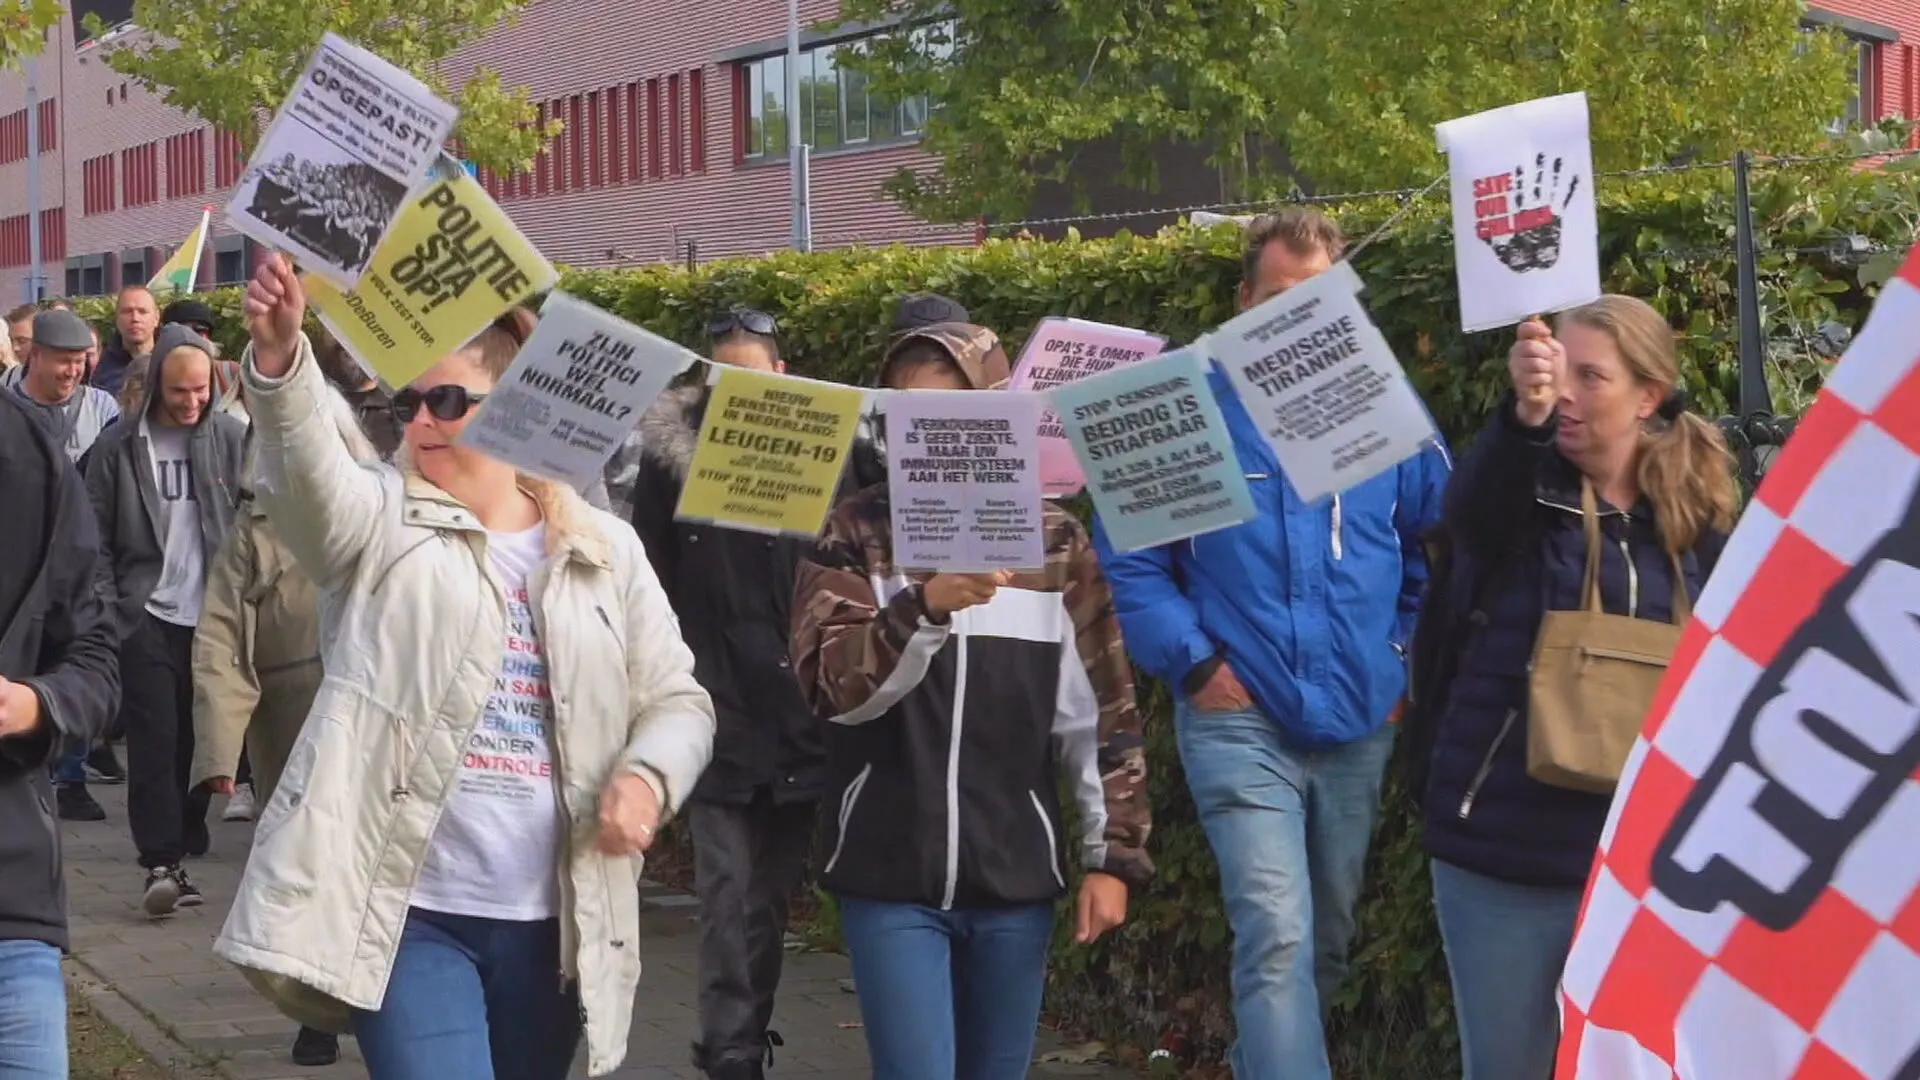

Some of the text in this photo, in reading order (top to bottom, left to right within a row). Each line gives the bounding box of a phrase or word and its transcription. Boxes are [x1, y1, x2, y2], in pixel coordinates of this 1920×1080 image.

[310, 68, 433, 152] OPGEPAST!
[419, 183, 530, 303] POLITIE
[416, 233, 476, 300] STA
[390, 256, 449, 315] OP!
[390, 298, 413, 321] ZEGT
[586, 330, 636, 362] ZIJN
[1045, 339, 1144, 361] OPA'S & OMA'S
[1242, 315, 1358, 383] MEDISCHE
[556, 340, 643, 386] POLITICI
[1060, 356, 1084, 368] DIE
[1256, 337, 1363, 397] TIRANNIE
[519, 366, 632, 421] NORMAAL?
[566, 366, 606, 393] WEL
[728, 396, 840, 424] ERNSTIG VIRUS
[764, 390, 813, 407] NIEUW
[1073, 400, 1112, 420] STOP
[723, 409, 837, 438] IN NEDERLAND:
[911, 418, 1009, 431] VERKOUDHEID
[1081, 395, 1198, 442] BEDROG IS
[708, 426, 837, 463] LEUGEN-19
[906, 432, 1017, 446] IS GEEN ZIEKTE,
[927, 446, 998, 457] MAAR UW
[1088, 414, 1208, 461] STRAFBAAR
[698, 469, 731, 482] STOP
[900, 458, 1025, 470] IMMUUNSYSTEEM
[908, 472, 1019, 483] AAN HET WERK.
[514, 703, 541, 718] WE
